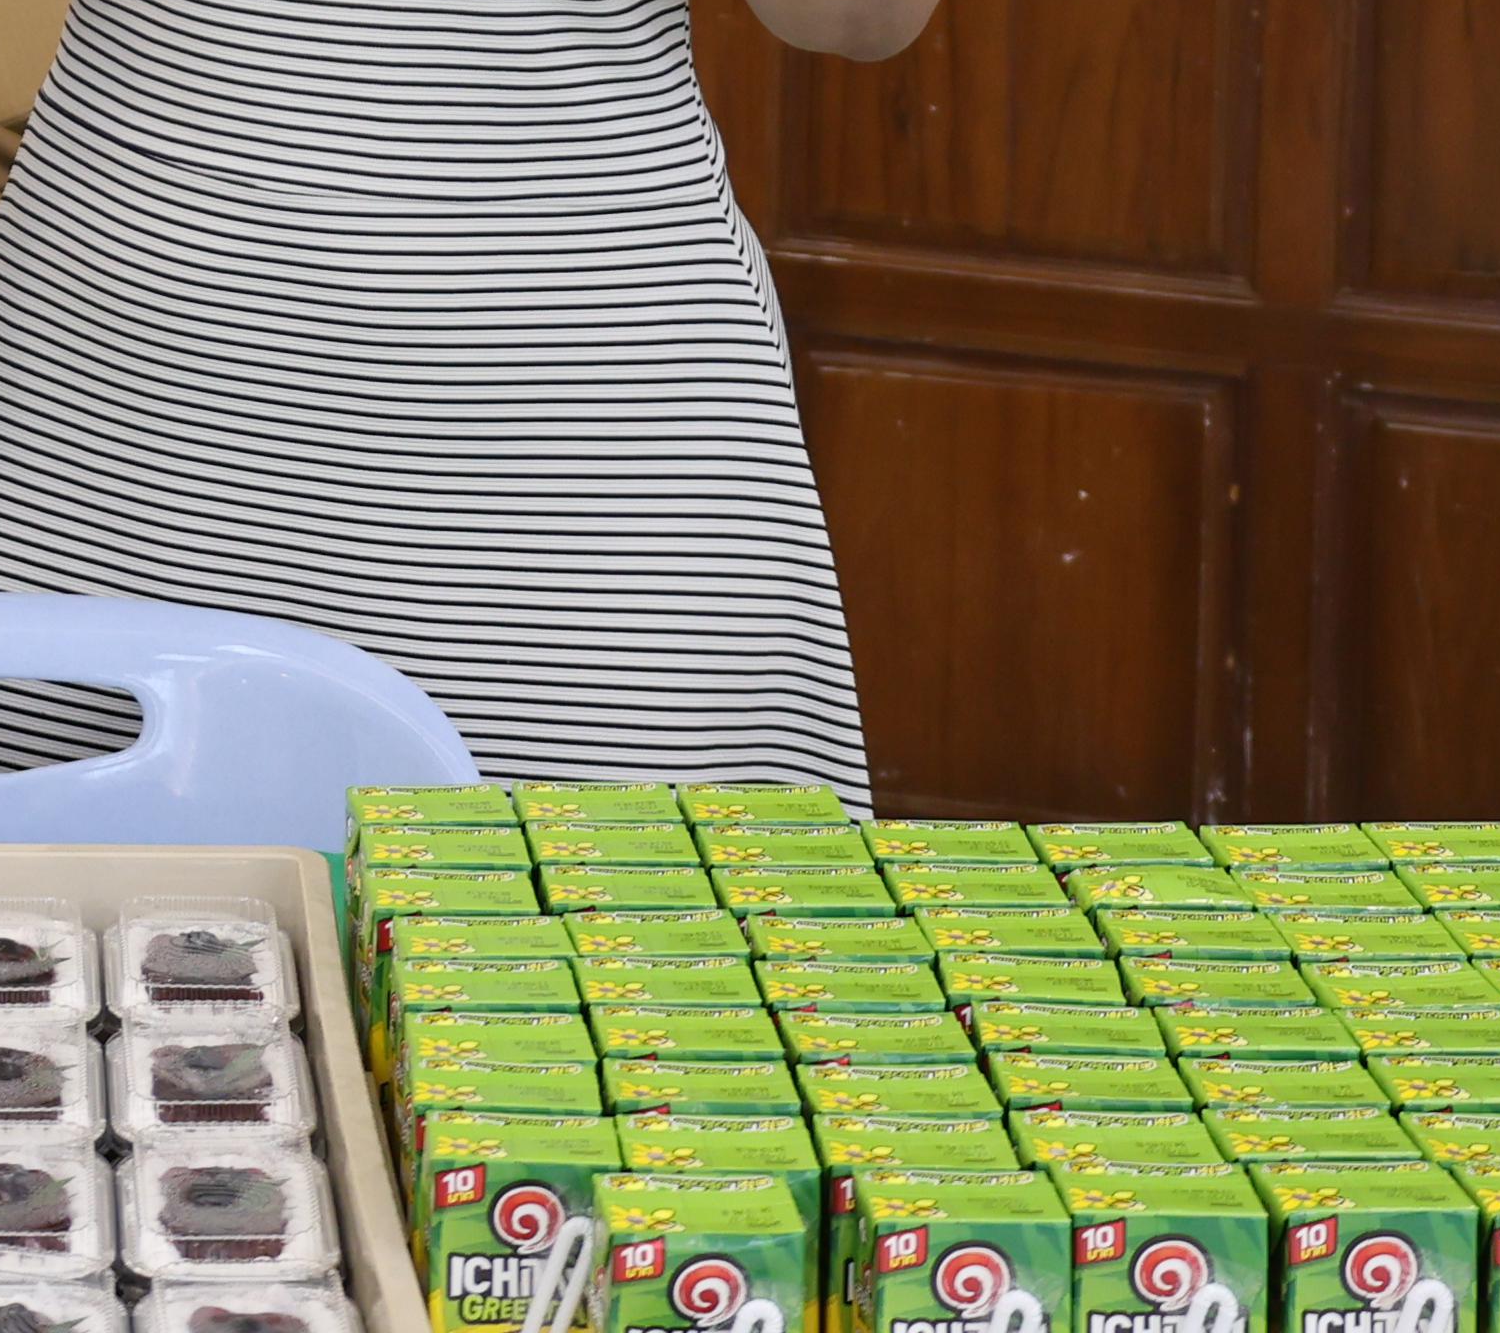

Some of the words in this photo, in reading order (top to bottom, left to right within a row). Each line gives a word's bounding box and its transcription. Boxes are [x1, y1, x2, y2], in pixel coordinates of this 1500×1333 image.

[443, 1170, 475, 1193] 10
[885, 1232, 916, 1255] 10
[1082, 1226, 1114, 1249] 10
[1296, 1224, 1327, 1247] 10
[621, 1245, 654, 1267] 10
